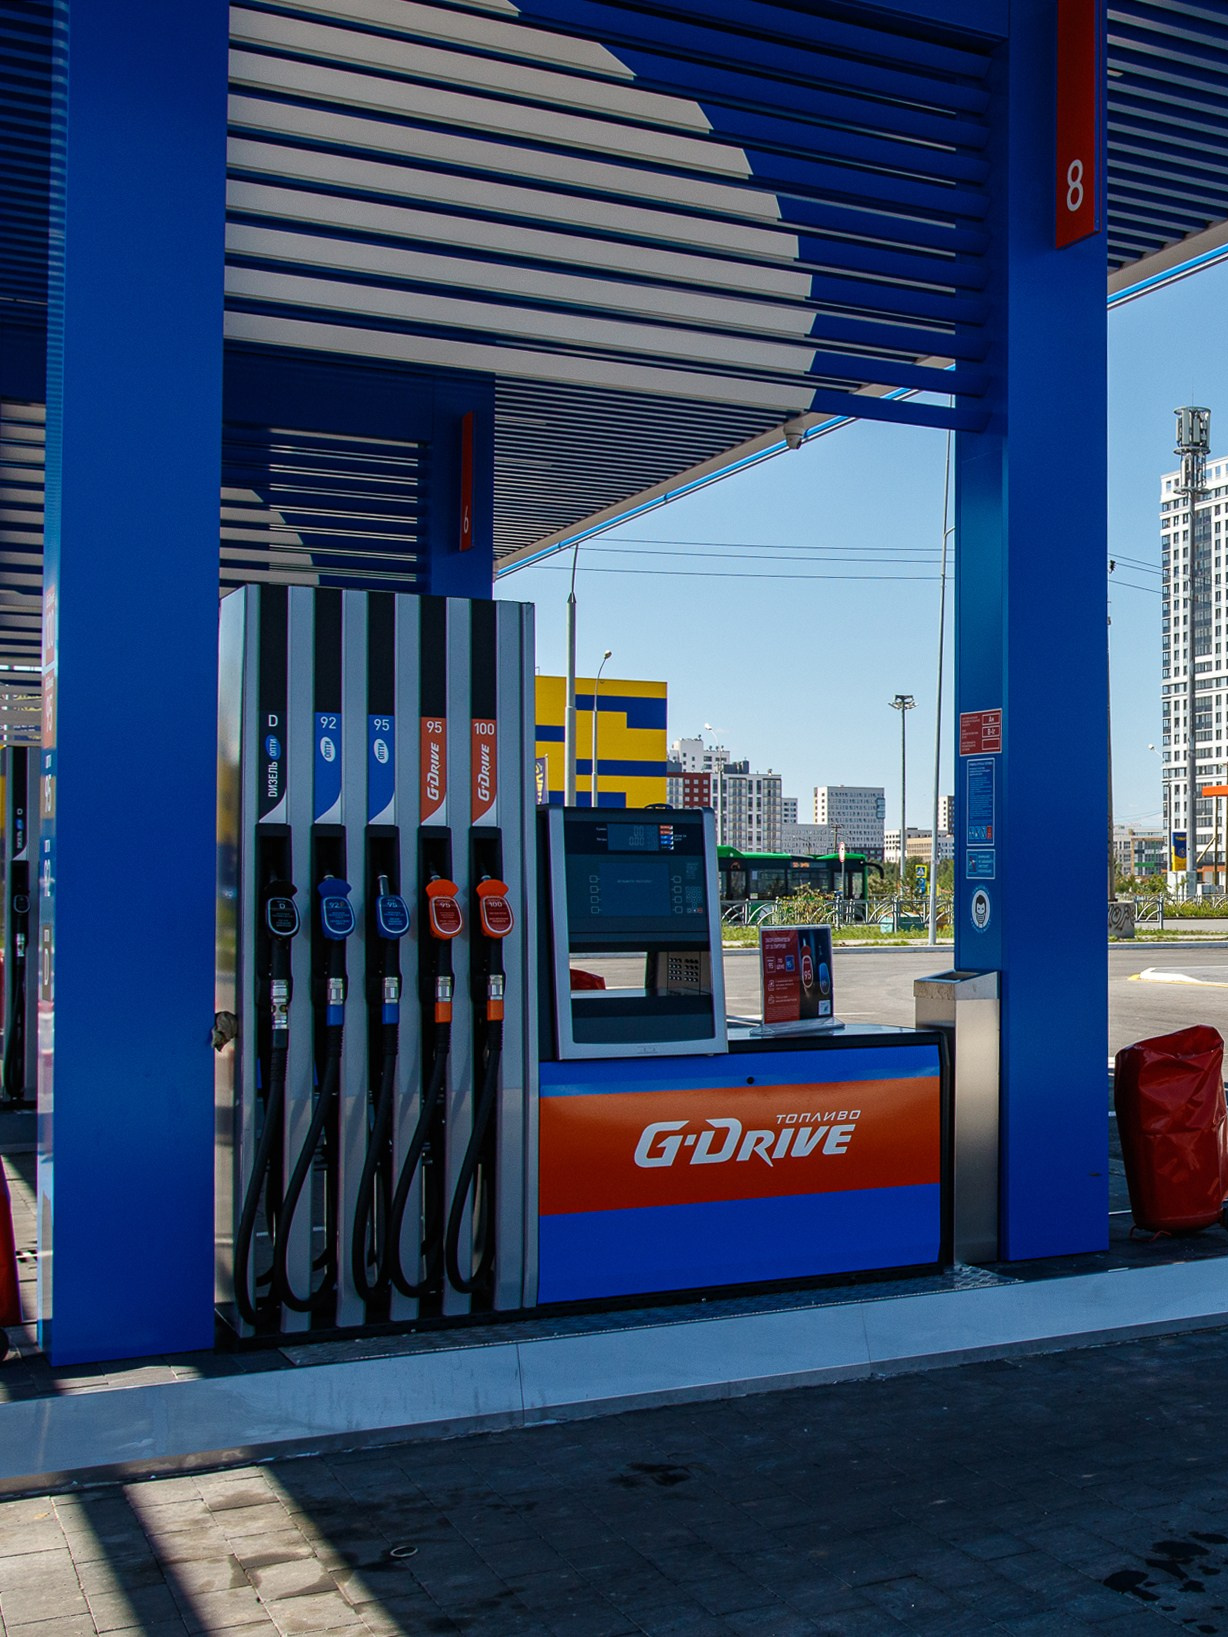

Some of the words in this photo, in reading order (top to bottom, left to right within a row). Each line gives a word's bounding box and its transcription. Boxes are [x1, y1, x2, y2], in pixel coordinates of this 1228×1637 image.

[1066, 159, 1084, 212] 8
[463, 505, 469, 534] 6
[268, 714, 278, 727] D
[320, 717, 336, 730] 92
[373, 718, 390, 731] 95
[426, 721, 442, 733] 95
[474, 722, 495, 735] 100
[270, 738, 278, 757] ОПТИ
[324, 740, 333, 759] ОПТИ
[377, 742, 386, 760] ОПТИ
[775, 1109, 862, 1125] ТОПЛИВО
